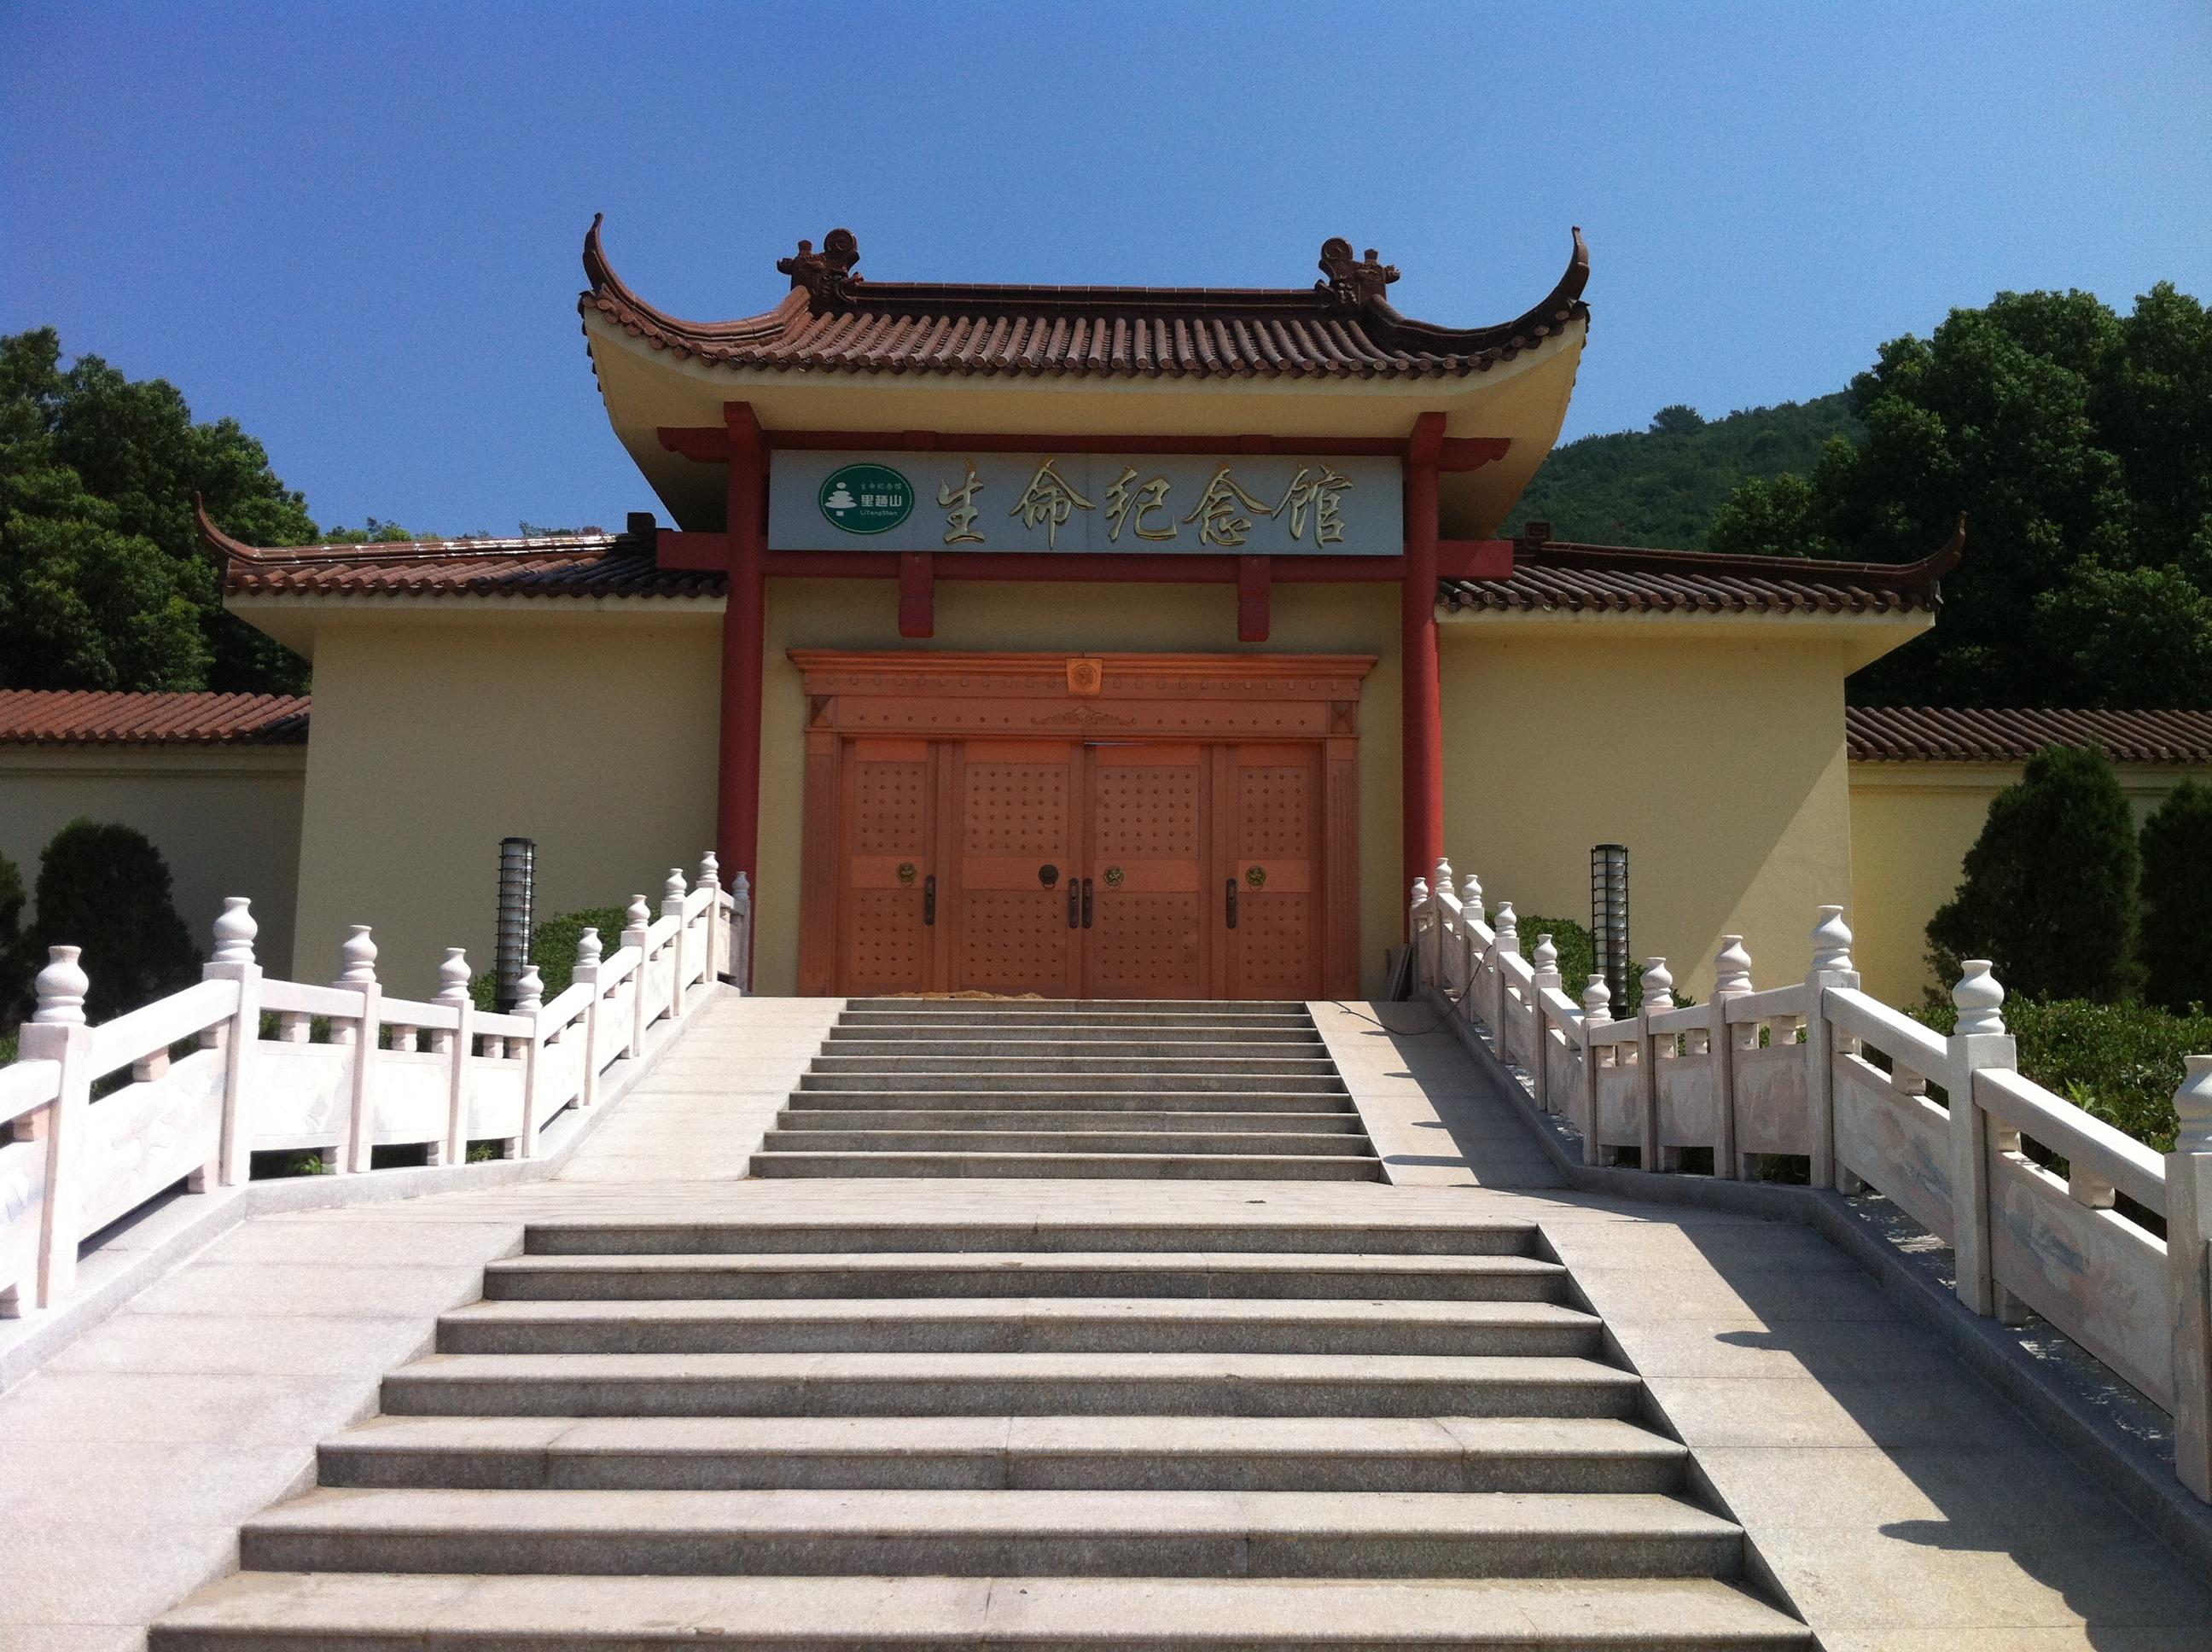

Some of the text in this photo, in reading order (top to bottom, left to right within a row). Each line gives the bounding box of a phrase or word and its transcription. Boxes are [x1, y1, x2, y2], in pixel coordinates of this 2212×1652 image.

[937, 459, 1353, 549] 生命纪念馆
